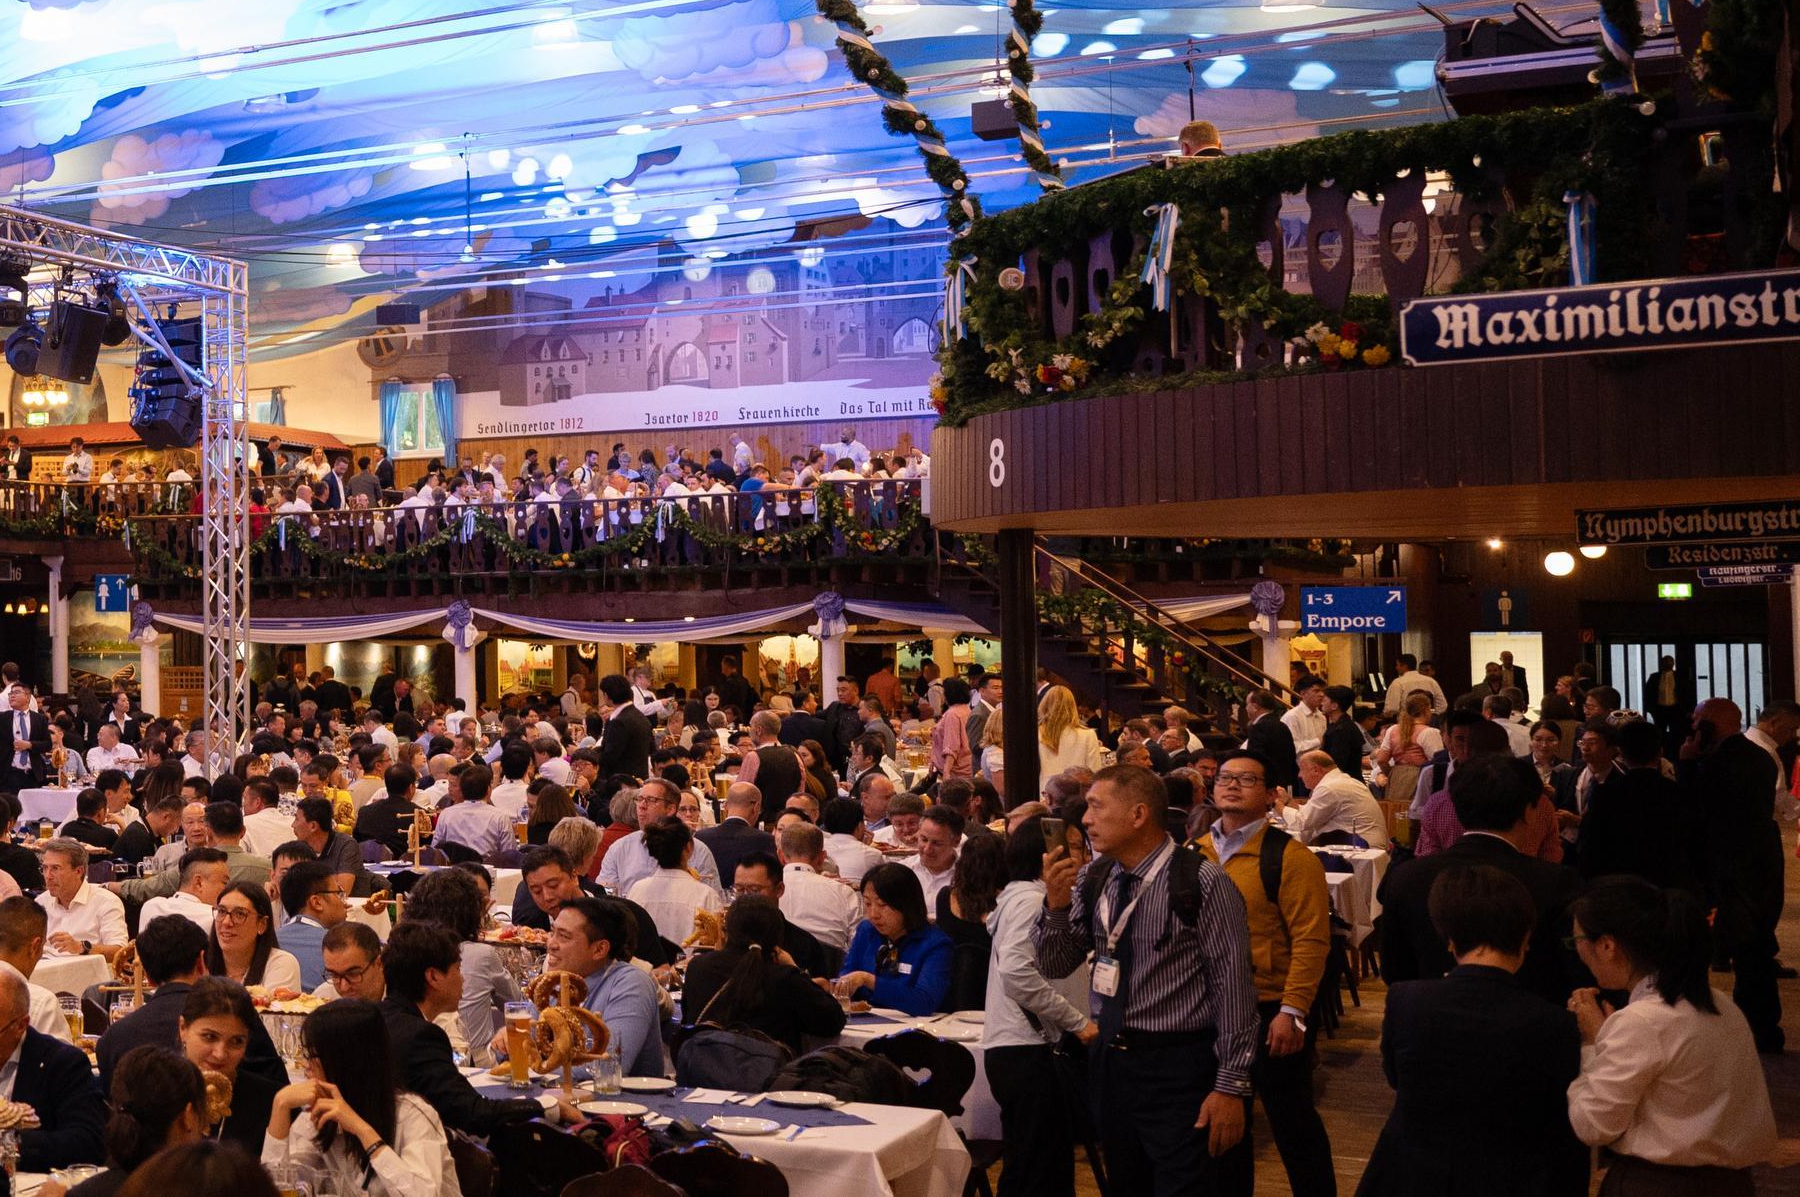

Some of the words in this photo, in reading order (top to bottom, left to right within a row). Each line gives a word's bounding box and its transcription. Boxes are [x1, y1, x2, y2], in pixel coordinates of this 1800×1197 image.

[1432, 281, 1800, 349] Maximilianstr
[738, 406, 820, 421] Frauenkirche
[840, 401, 863, 415] Das
[869, 400, 887, 413] Tal
[891, 399, 913, 412] mit
[693, 411, 719, 423] 1820
[477, 421, 555, 434] Sendlingertor
[560, 417, 584, 429] 1812
[989, 438, 1006, 488] 8
[1667, 543, 1788, 563] Residenzstr.
[10, 567, 22, 581] 16
[1307, 594, 1334, 605] 1-3
[1307, 614, 1386, 631] Empore
